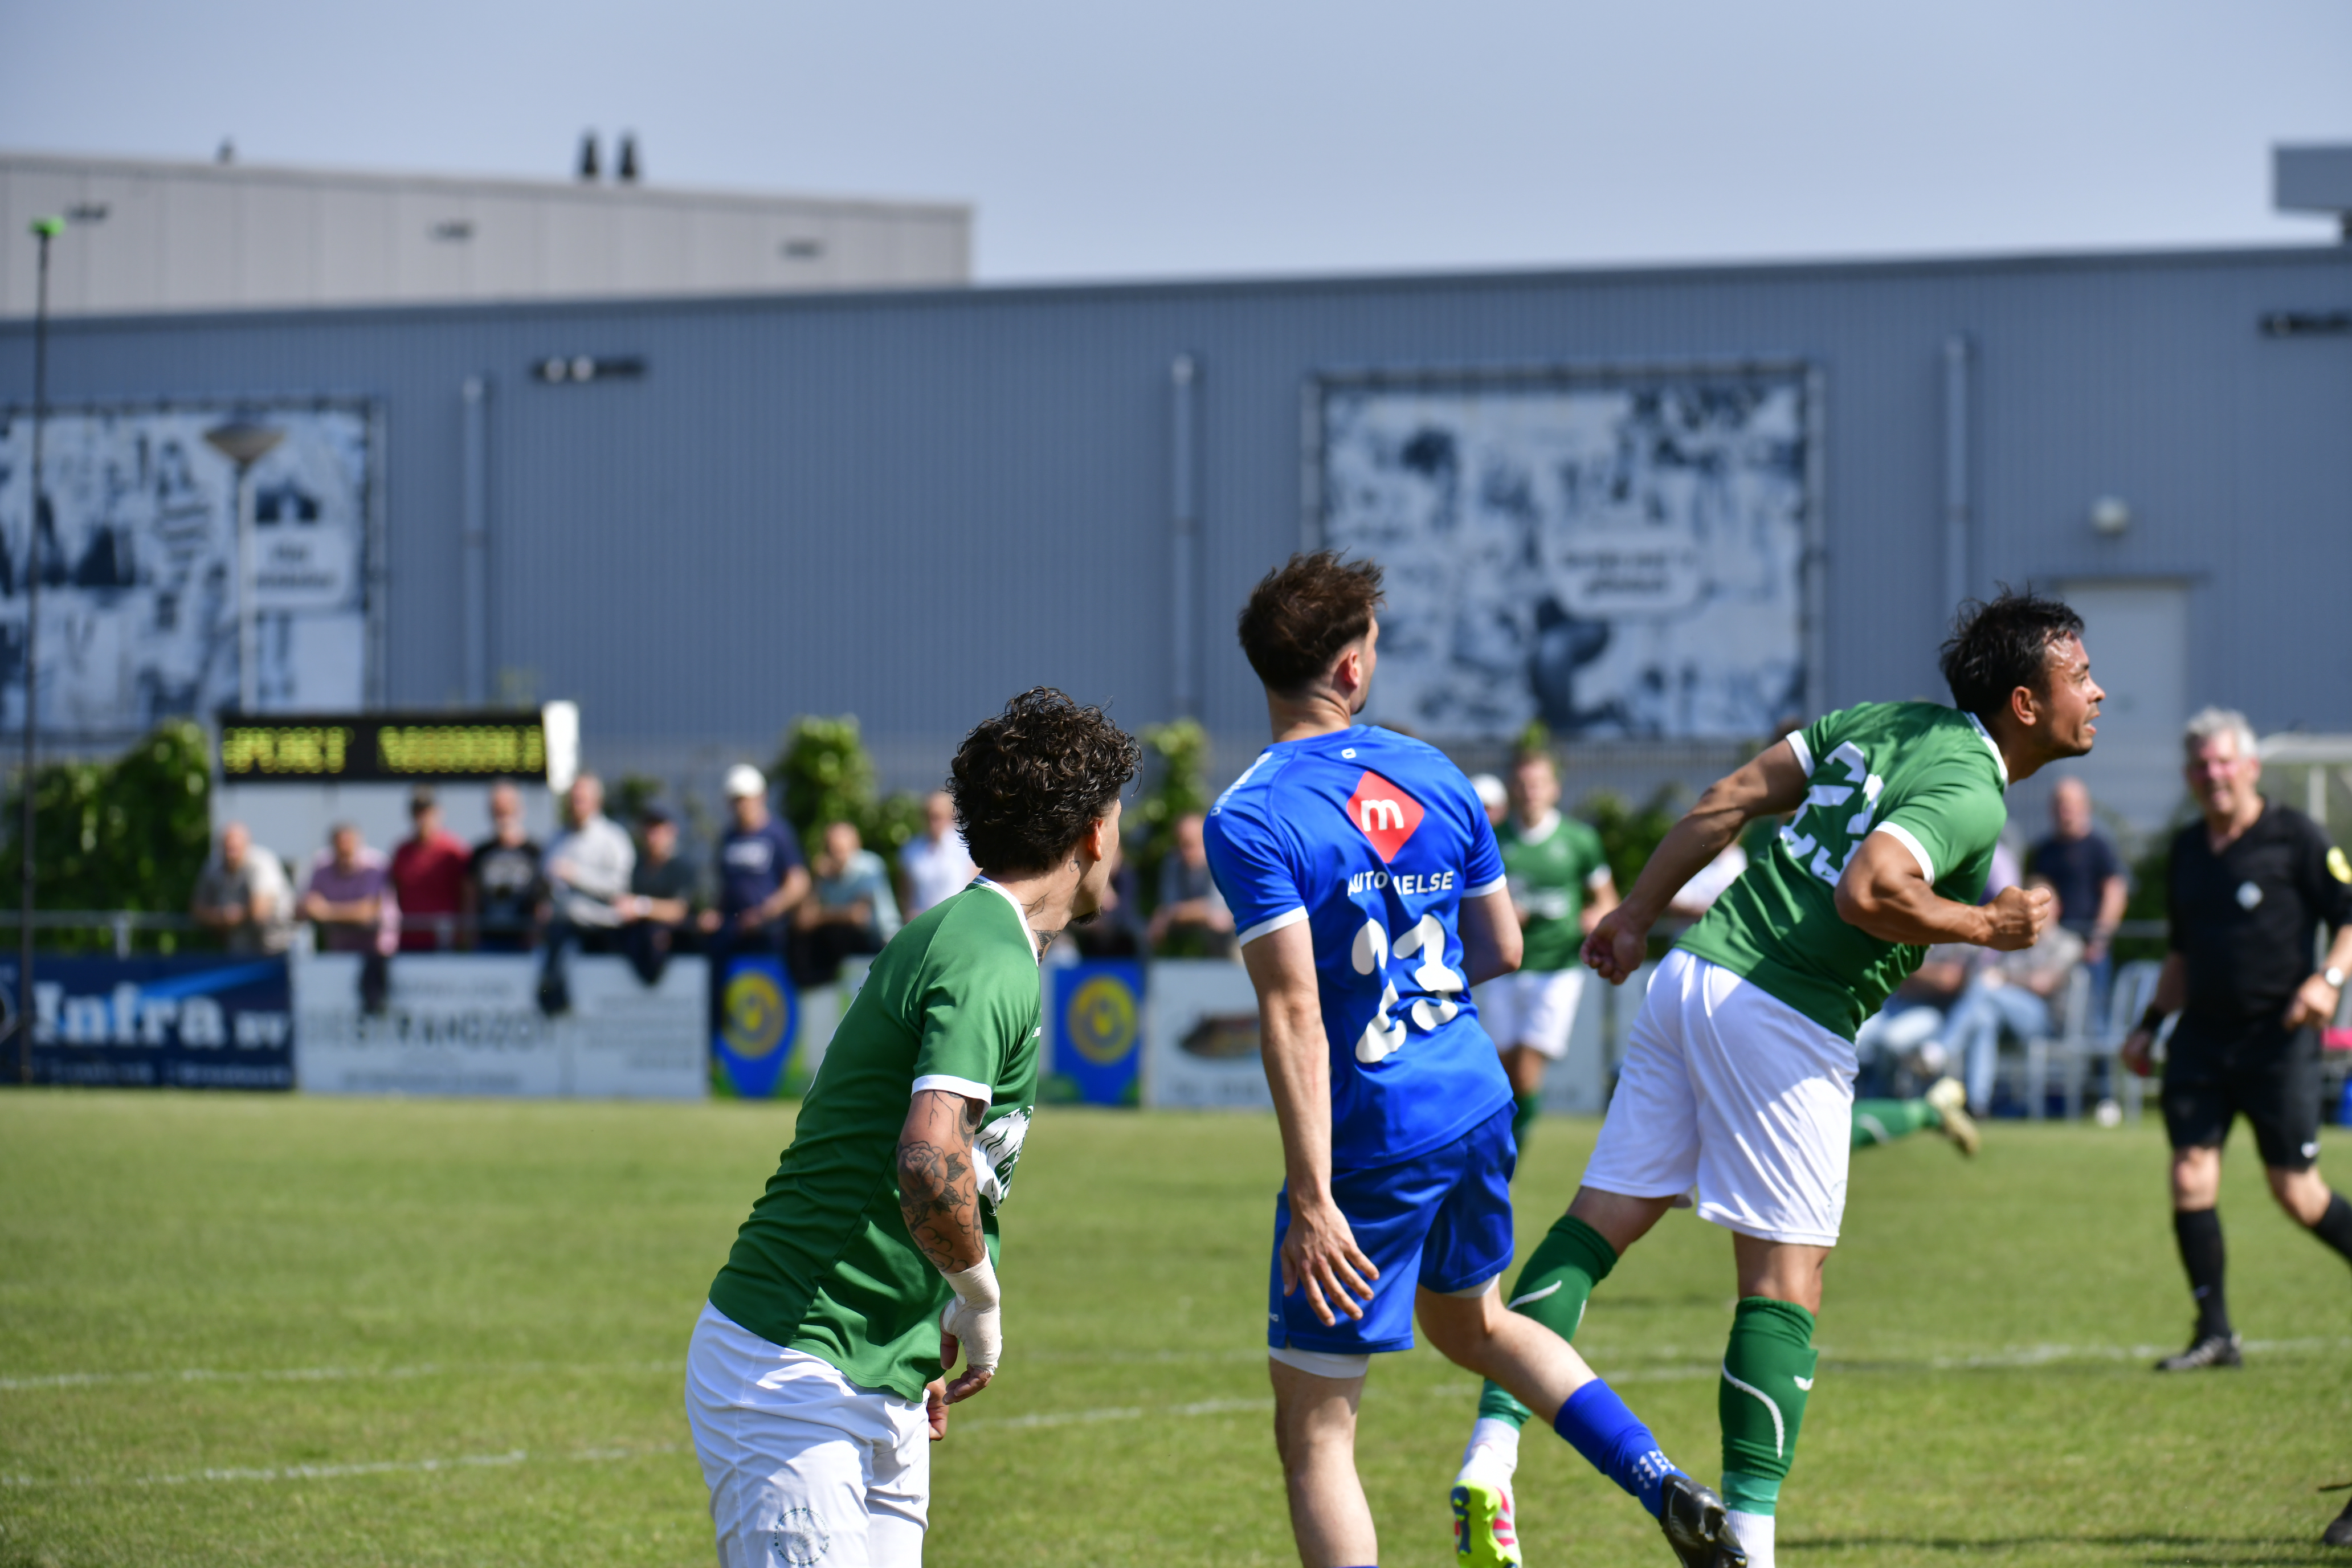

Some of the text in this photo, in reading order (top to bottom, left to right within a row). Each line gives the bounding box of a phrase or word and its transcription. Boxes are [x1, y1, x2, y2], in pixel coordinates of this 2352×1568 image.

[1360, 799, 1404, 831] m
[1779, 740, 1884, 887] 23
[1348, 870, 1389, 897] AUTO
[1351, 913, 1464, 1063] 23
